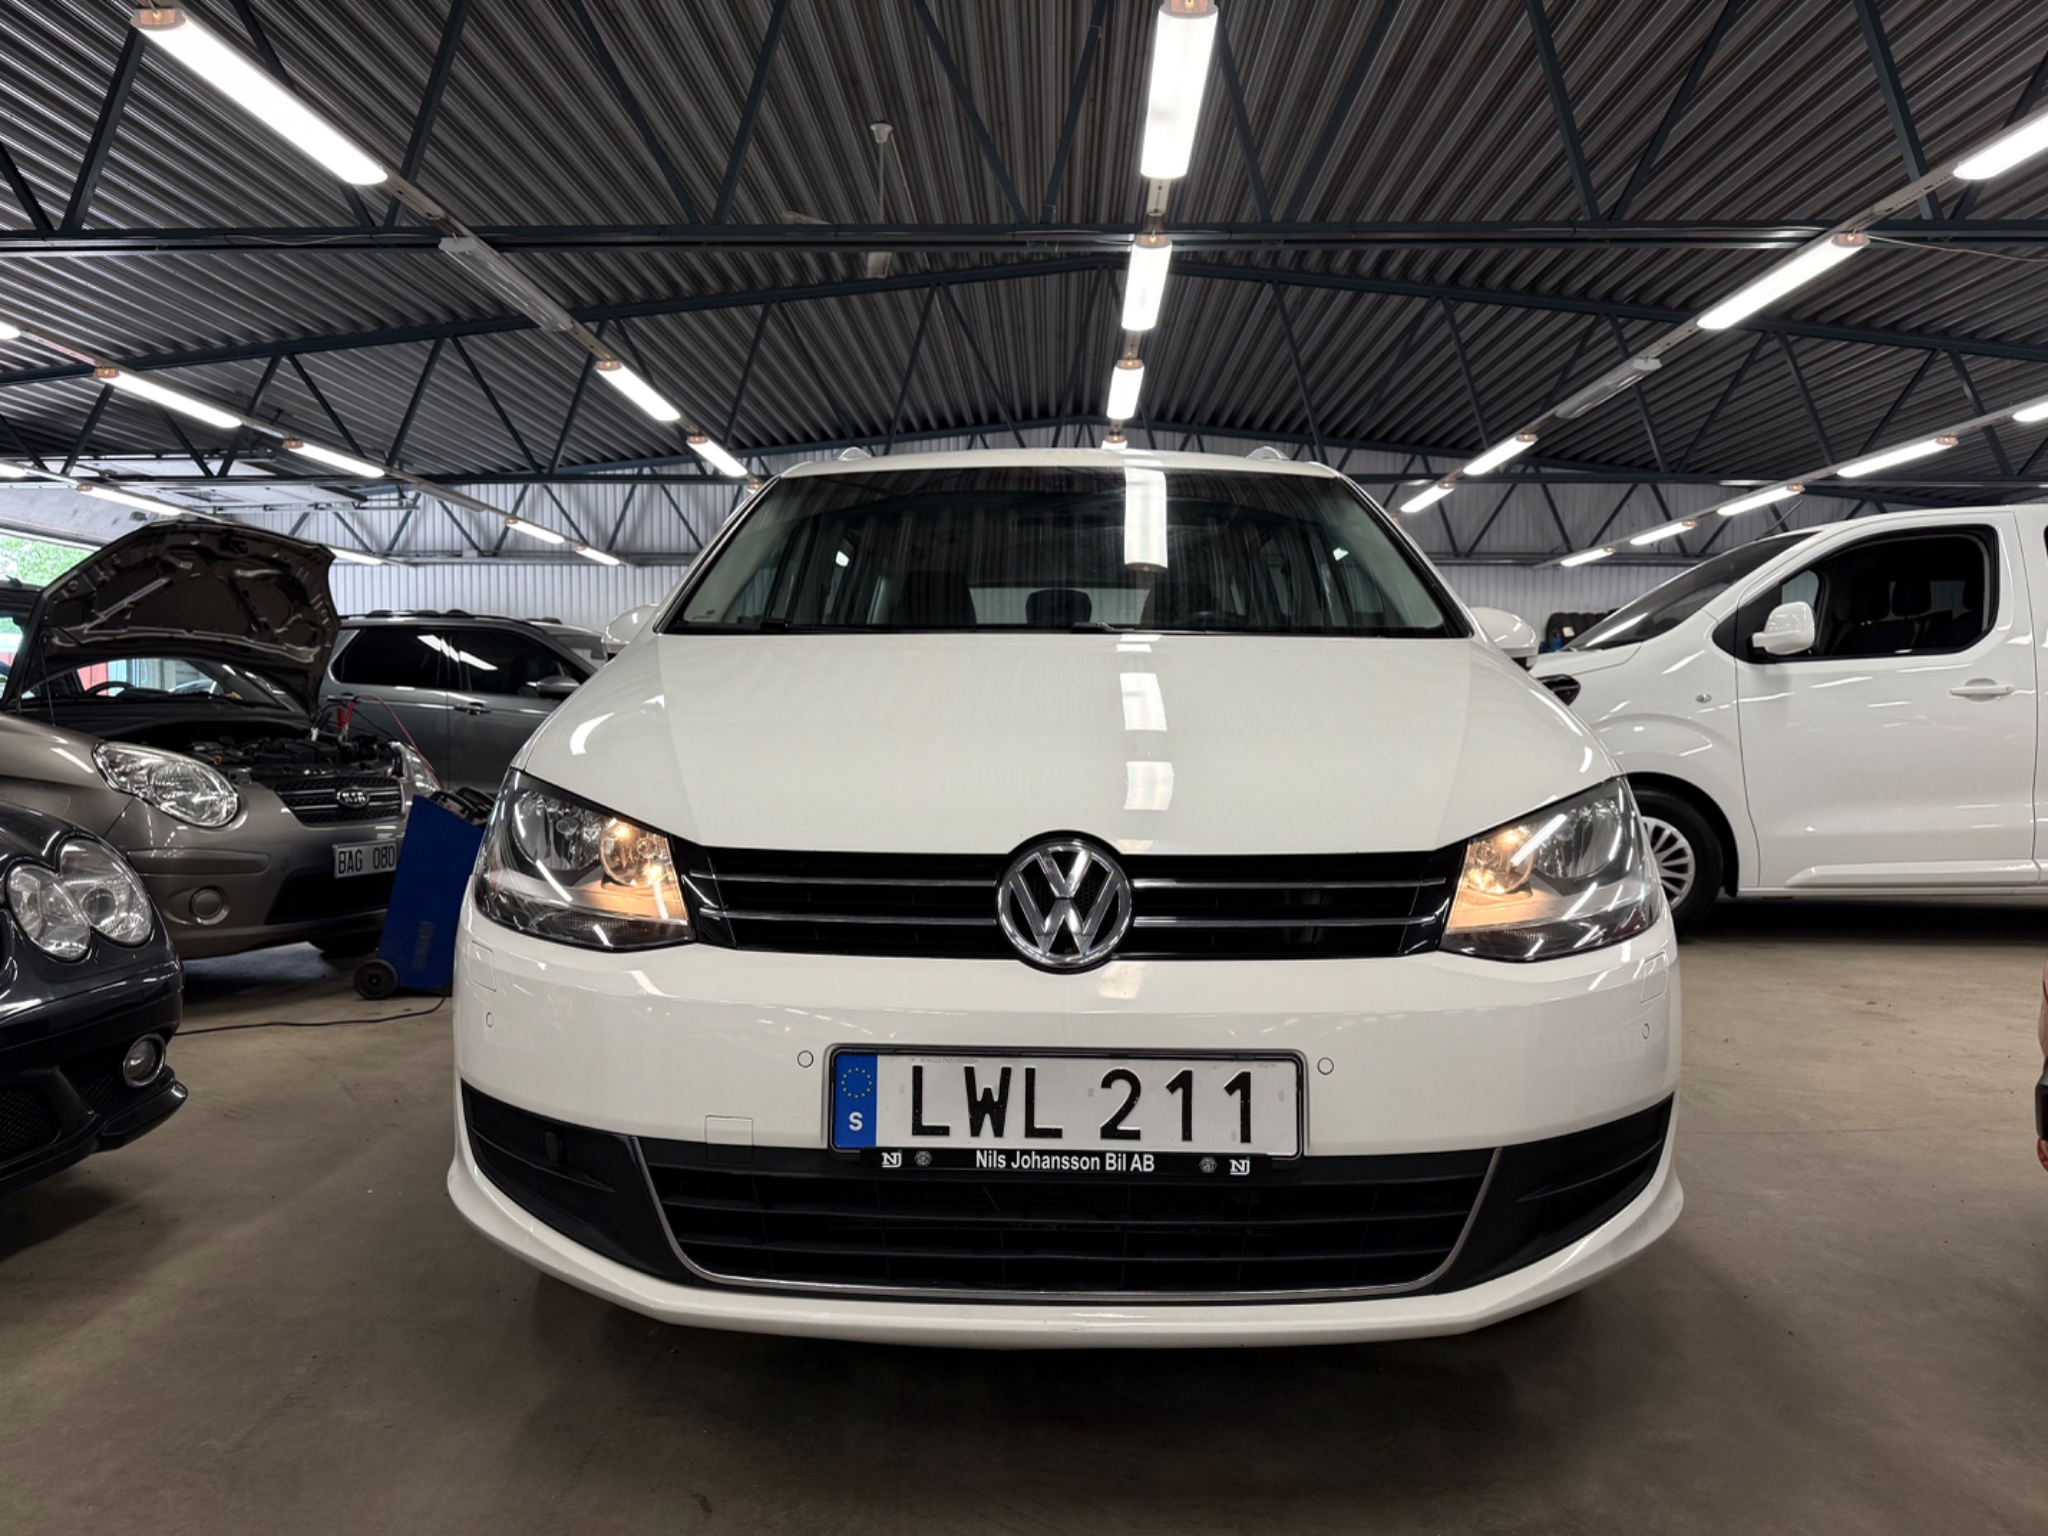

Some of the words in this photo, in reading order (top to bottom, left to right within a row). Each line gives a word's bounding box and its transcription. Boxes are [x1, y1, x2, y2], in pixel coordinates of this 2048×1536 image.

[338, 848, 363, 874] BAG
[372, 845, 395, 869] 080
[1003, 843, 1127, 961] VW
[911, 1065, 1063, 1139] LWL
[1100, 1069, 1252, 1144] 211
[848, 1112, 863, 1132] S
[976, 1150, 1006, 1169] Nils
[1011, 1151, 1101, 1171] Johansson
[1105, 1152, 1127, 1172] Bil
[1129, 1154, 1156, 1173] AB
